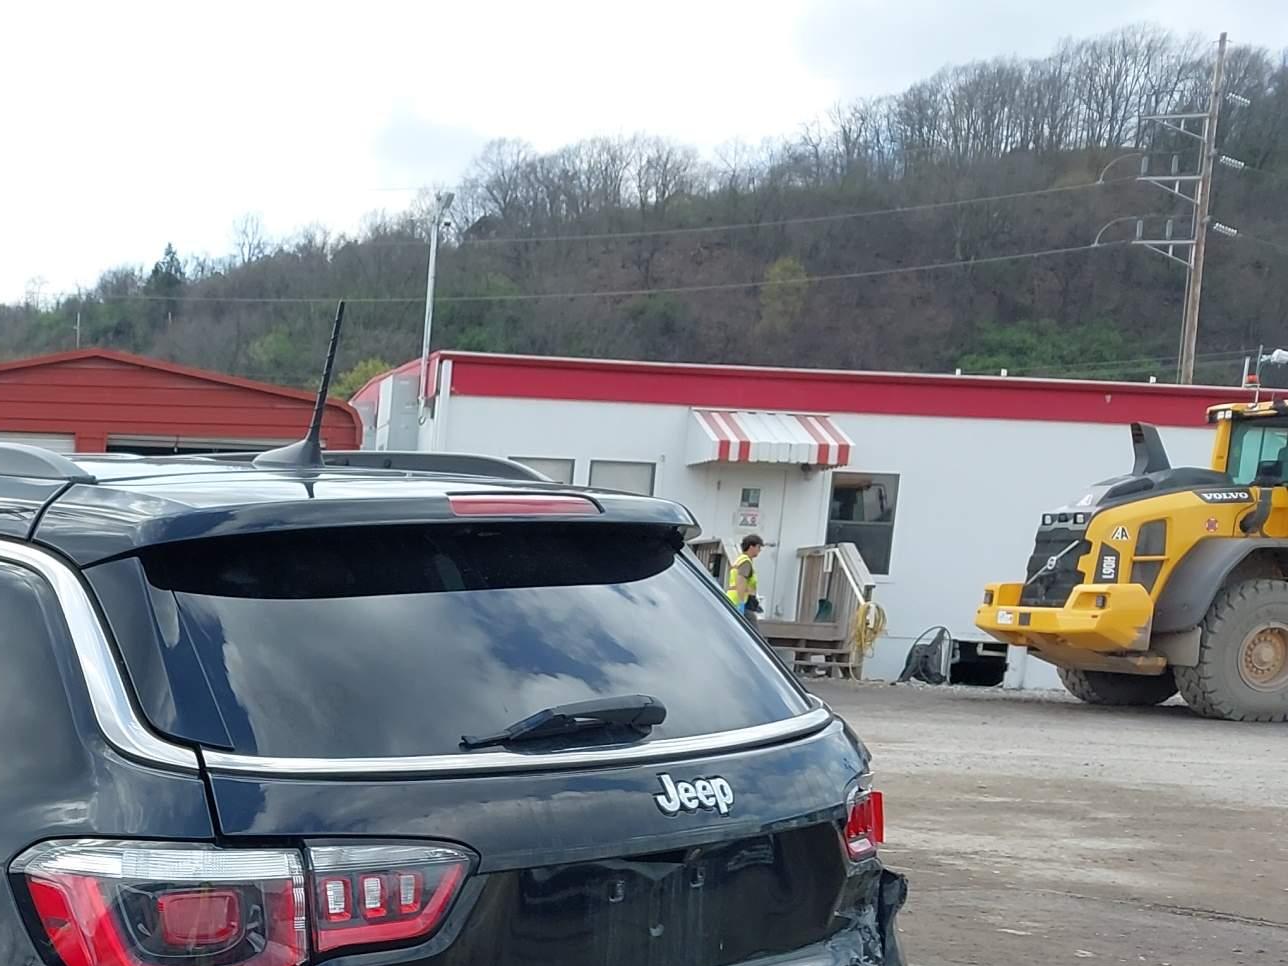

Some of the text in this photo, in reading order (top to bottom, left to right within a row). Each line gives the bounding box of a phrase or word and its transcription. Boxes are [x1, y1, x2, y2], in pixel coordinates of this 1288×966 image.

[1201, 491, 1249, 500] VOLVO
[1101, 555, 1117, 579] L90H
[654, 773, 734, 815] Jeep
